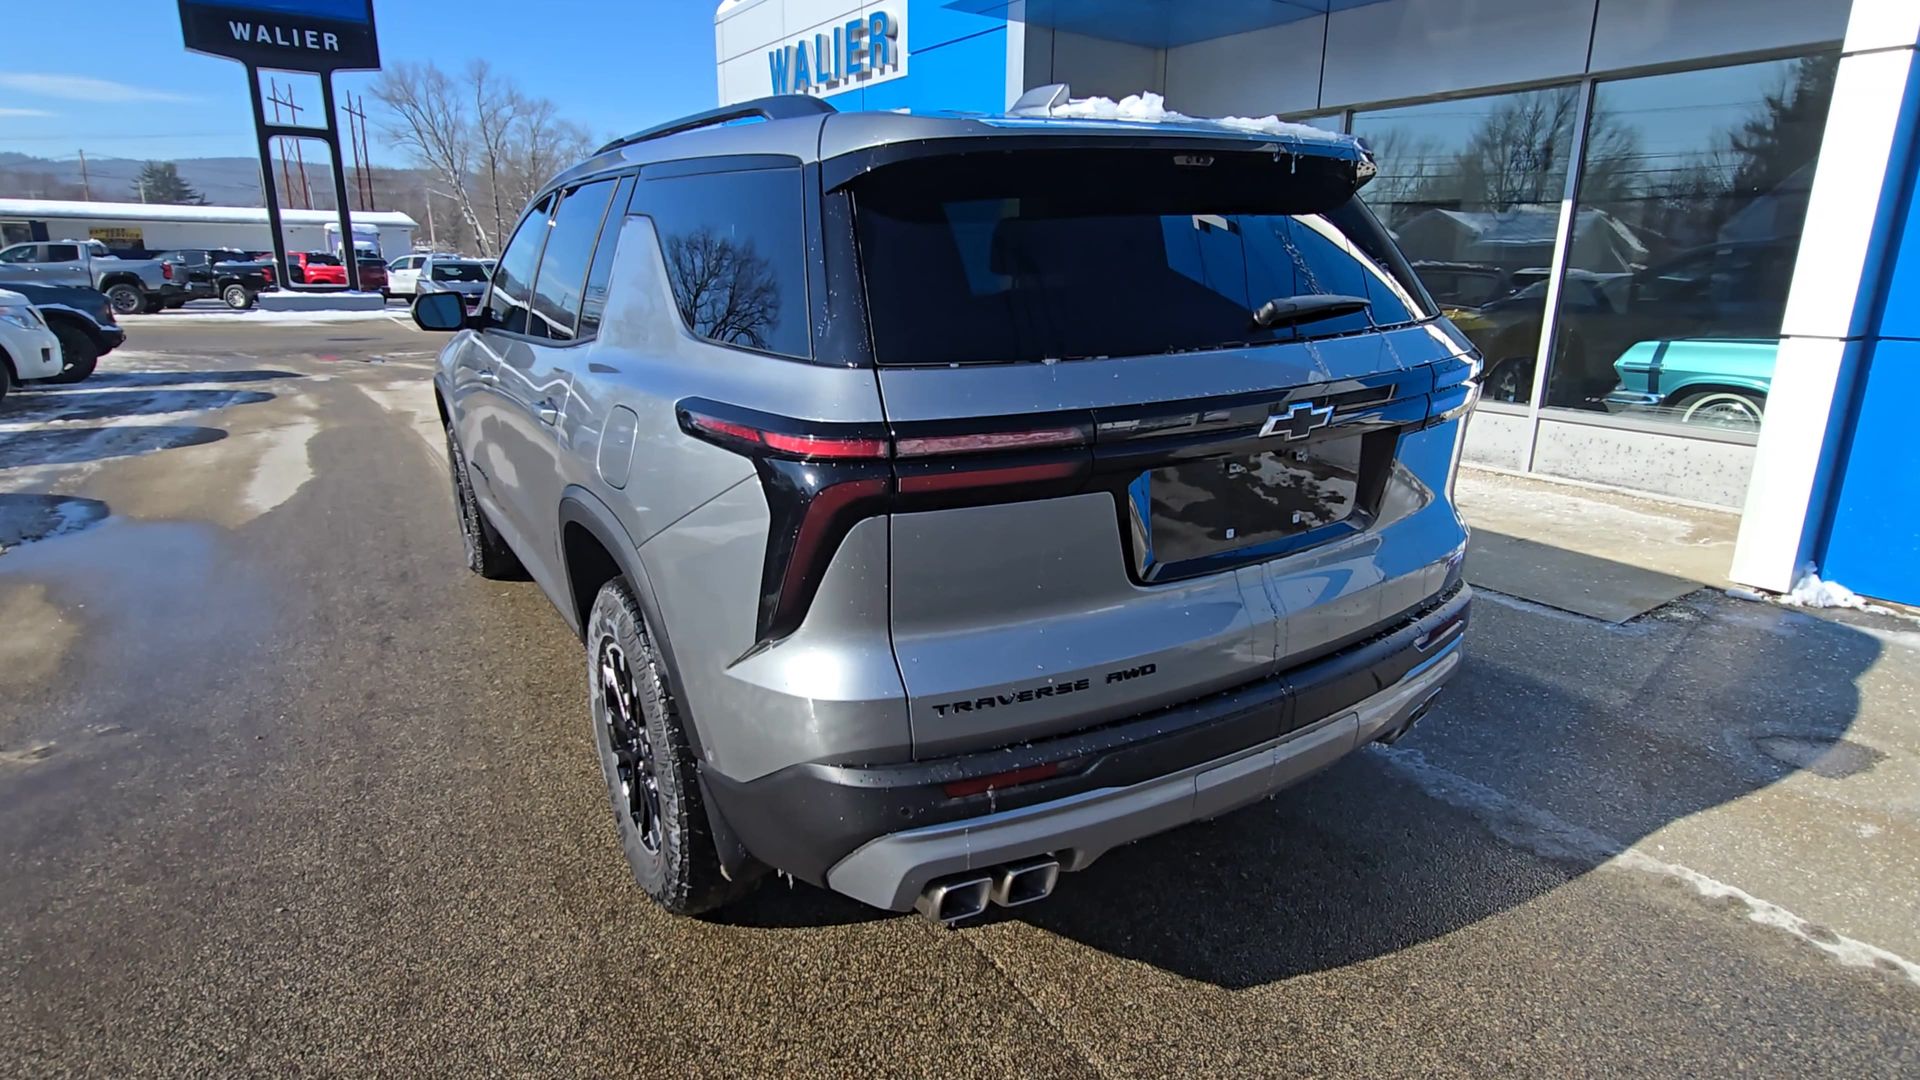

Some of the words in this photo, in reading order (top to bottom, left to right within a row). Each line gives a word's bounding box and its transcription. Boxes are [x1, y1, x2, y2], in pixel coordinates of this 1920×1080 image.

[229, 21, 340, 51] WALIER
[768, 11, 898, 95] WALIER
[932, 679, 1090, 716] TRAVERSE
[1106, 664, 1157, 684] AWD
